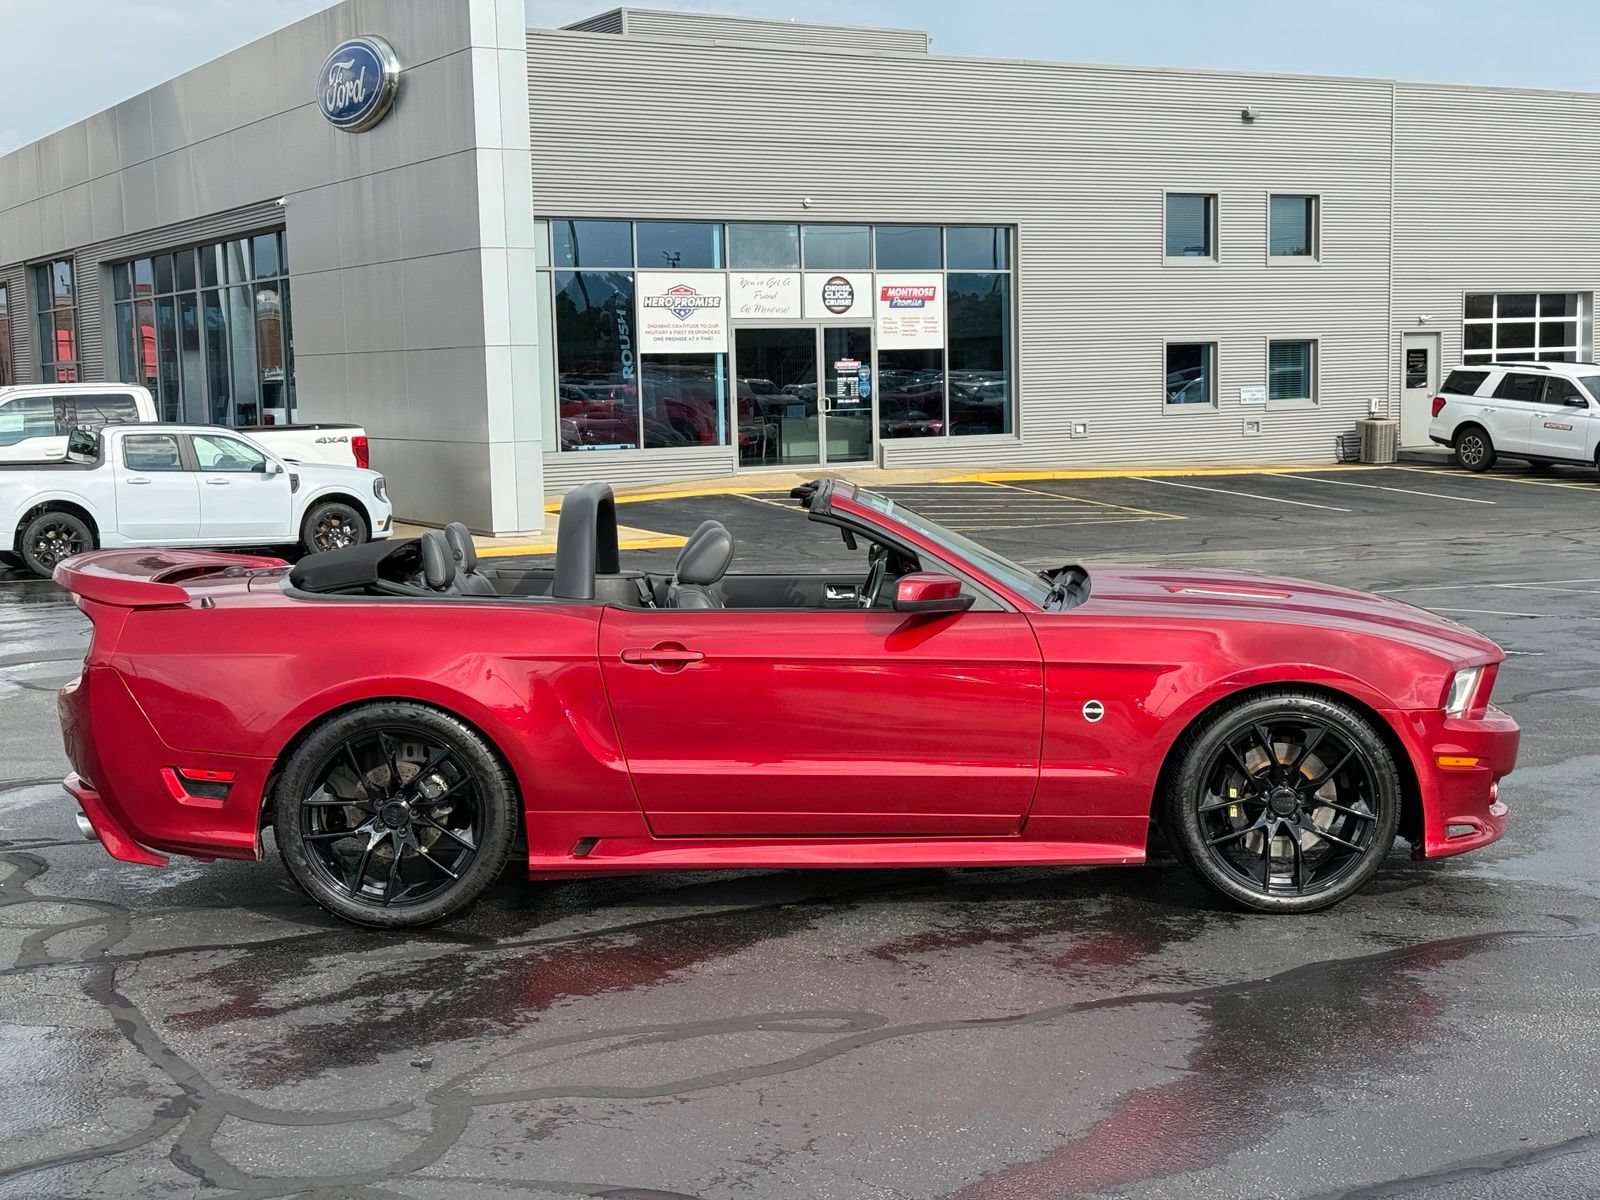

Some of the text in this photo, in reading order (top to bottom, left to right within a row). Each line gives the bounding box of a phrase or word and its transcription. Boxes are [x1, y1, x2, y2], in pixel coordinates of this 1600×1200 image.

[326, 58, 366, 112] Ford
[887, 287, 935, 297] MONTROSE
[643, 296, 721, 308] HERO PROMISE
[892, 297, 923, 308] Promise
[616, 309, 634, 379] ROUSH
[315, 436, 348, 444] 4X4
